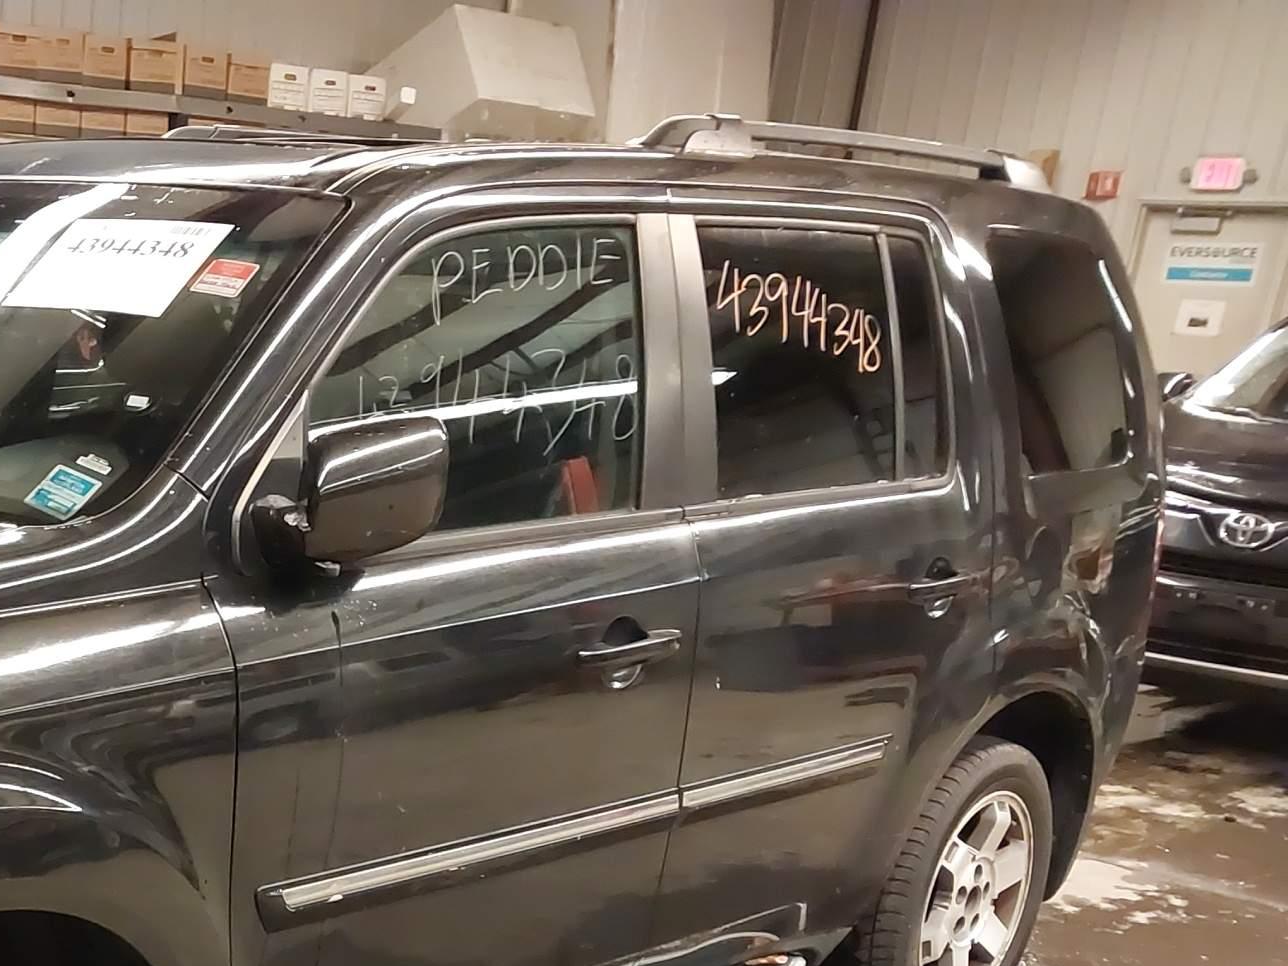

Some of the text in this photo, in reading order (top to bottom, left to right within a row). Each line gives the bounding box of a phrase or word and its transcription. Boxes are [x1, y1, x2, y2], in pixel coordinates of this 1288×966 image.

[67, 237, 195, 259] 43944348
[1170, 247, 1257, 258] EVERSOURCE
[431, 235, 621, 326] PEDDIE
[715, 260, 882, 374] 43944348
